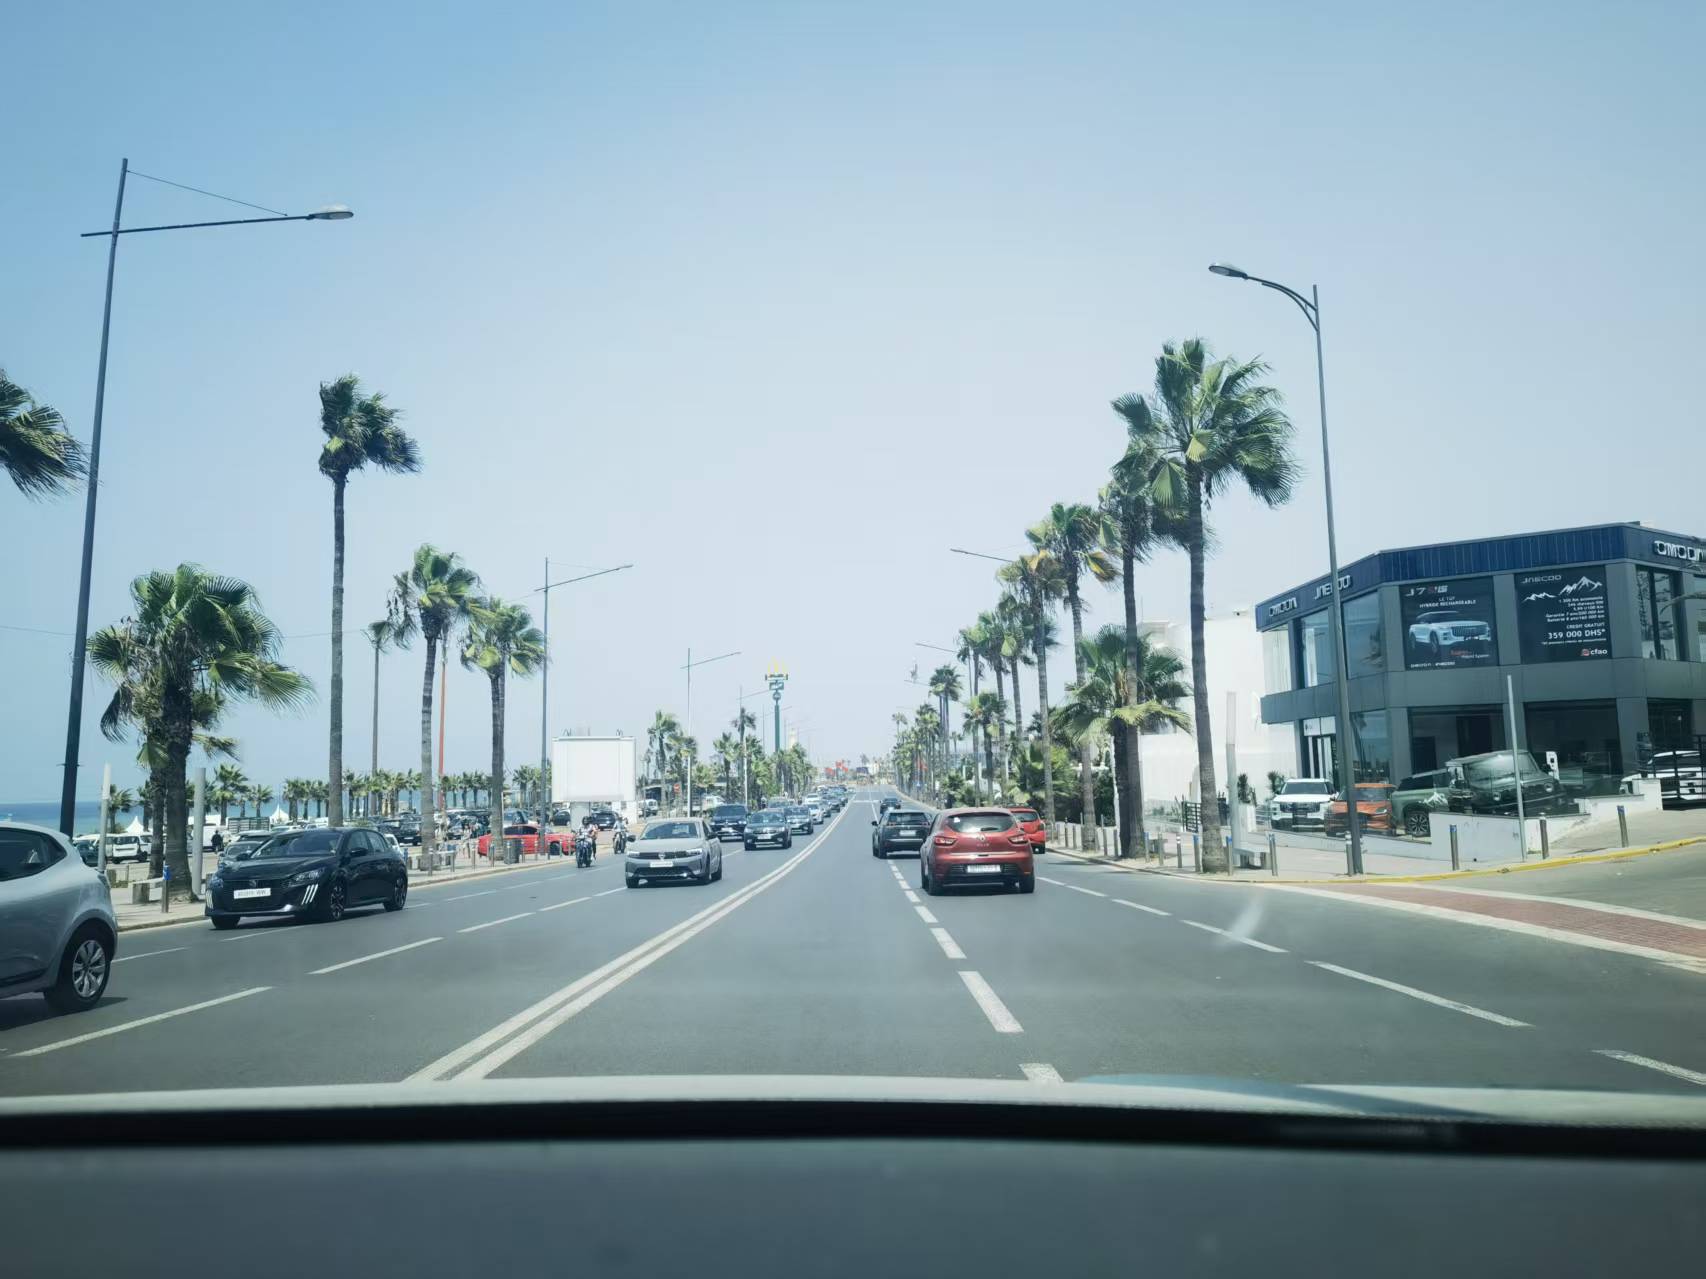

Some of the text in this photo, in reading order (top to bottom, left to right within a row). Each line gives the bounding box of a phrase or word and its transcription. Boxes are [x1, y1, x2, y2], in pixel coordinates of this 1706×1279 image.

[1314, 575, 1351, 600] JAEOO
[1548, 632, 1563, 640] 359
[1566, 630, 1582, 638] 000
[1590, 647, 1608, 655] cfao
